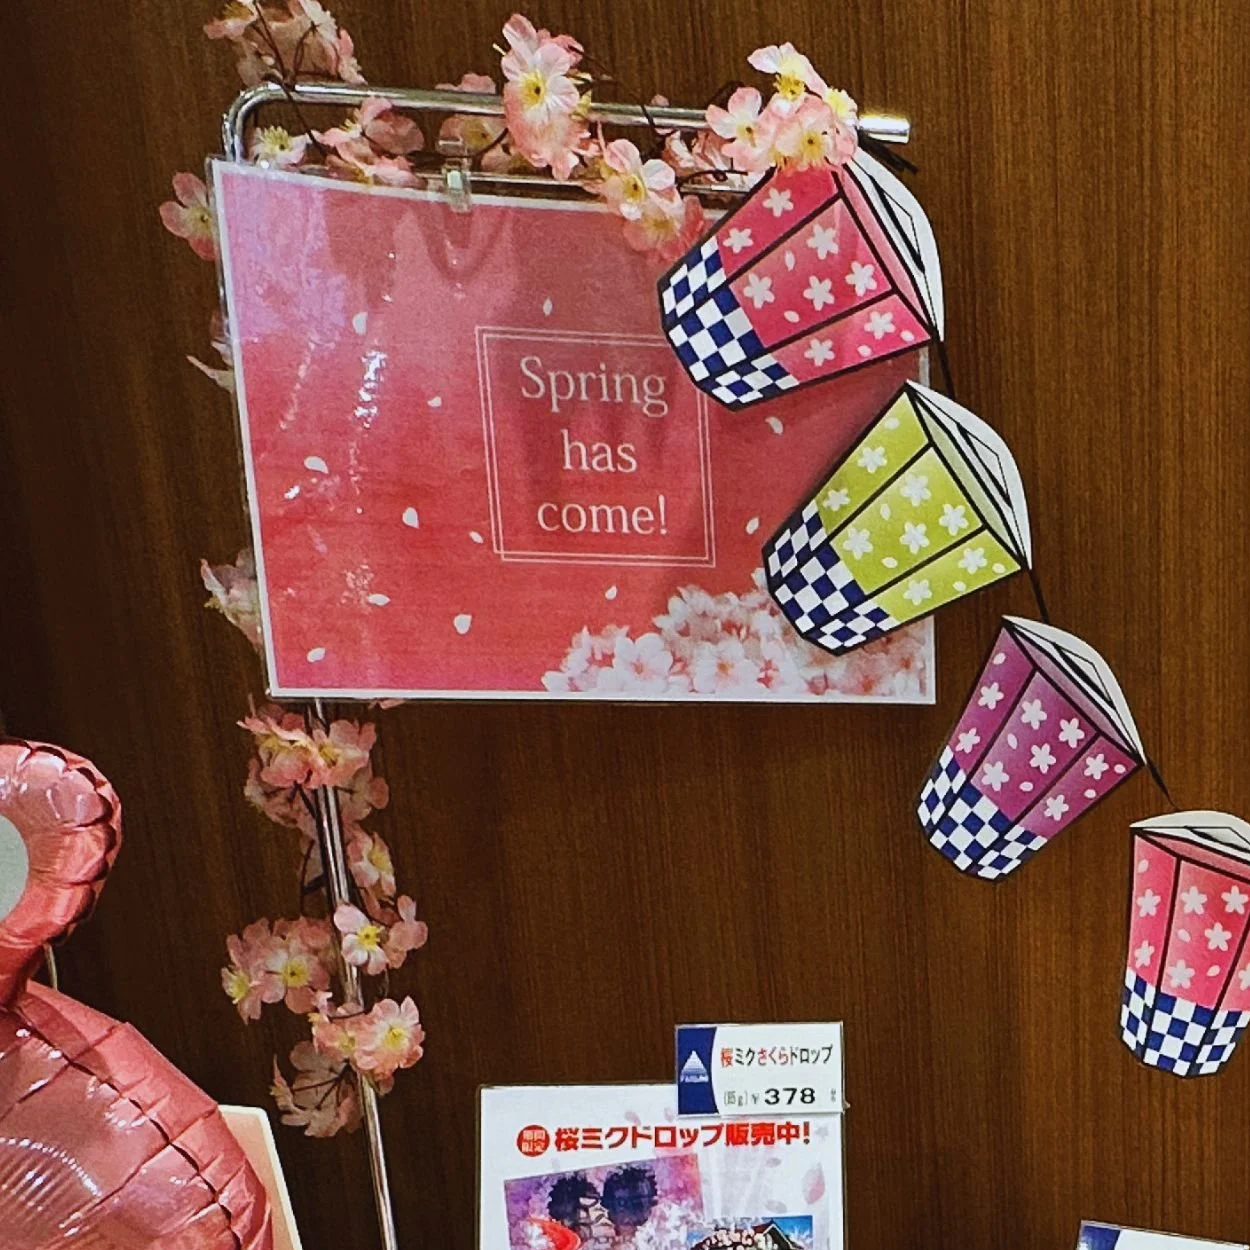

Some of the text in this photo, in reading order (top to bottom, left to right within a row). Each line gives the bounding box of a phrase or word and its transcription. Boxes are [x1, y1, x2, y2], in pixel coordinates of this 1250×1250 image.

[519, 355, 669, 417] Spring
[561, 428, 638, 473] has
[536, 493, 668, 536] come!
[720, 1044, 834, 1069] 桜ミクさくらドロップ
[764, 1087, 816, 1106] 378
[554, 1121, 811, 1152] 桜ミクドロップ販売中!
